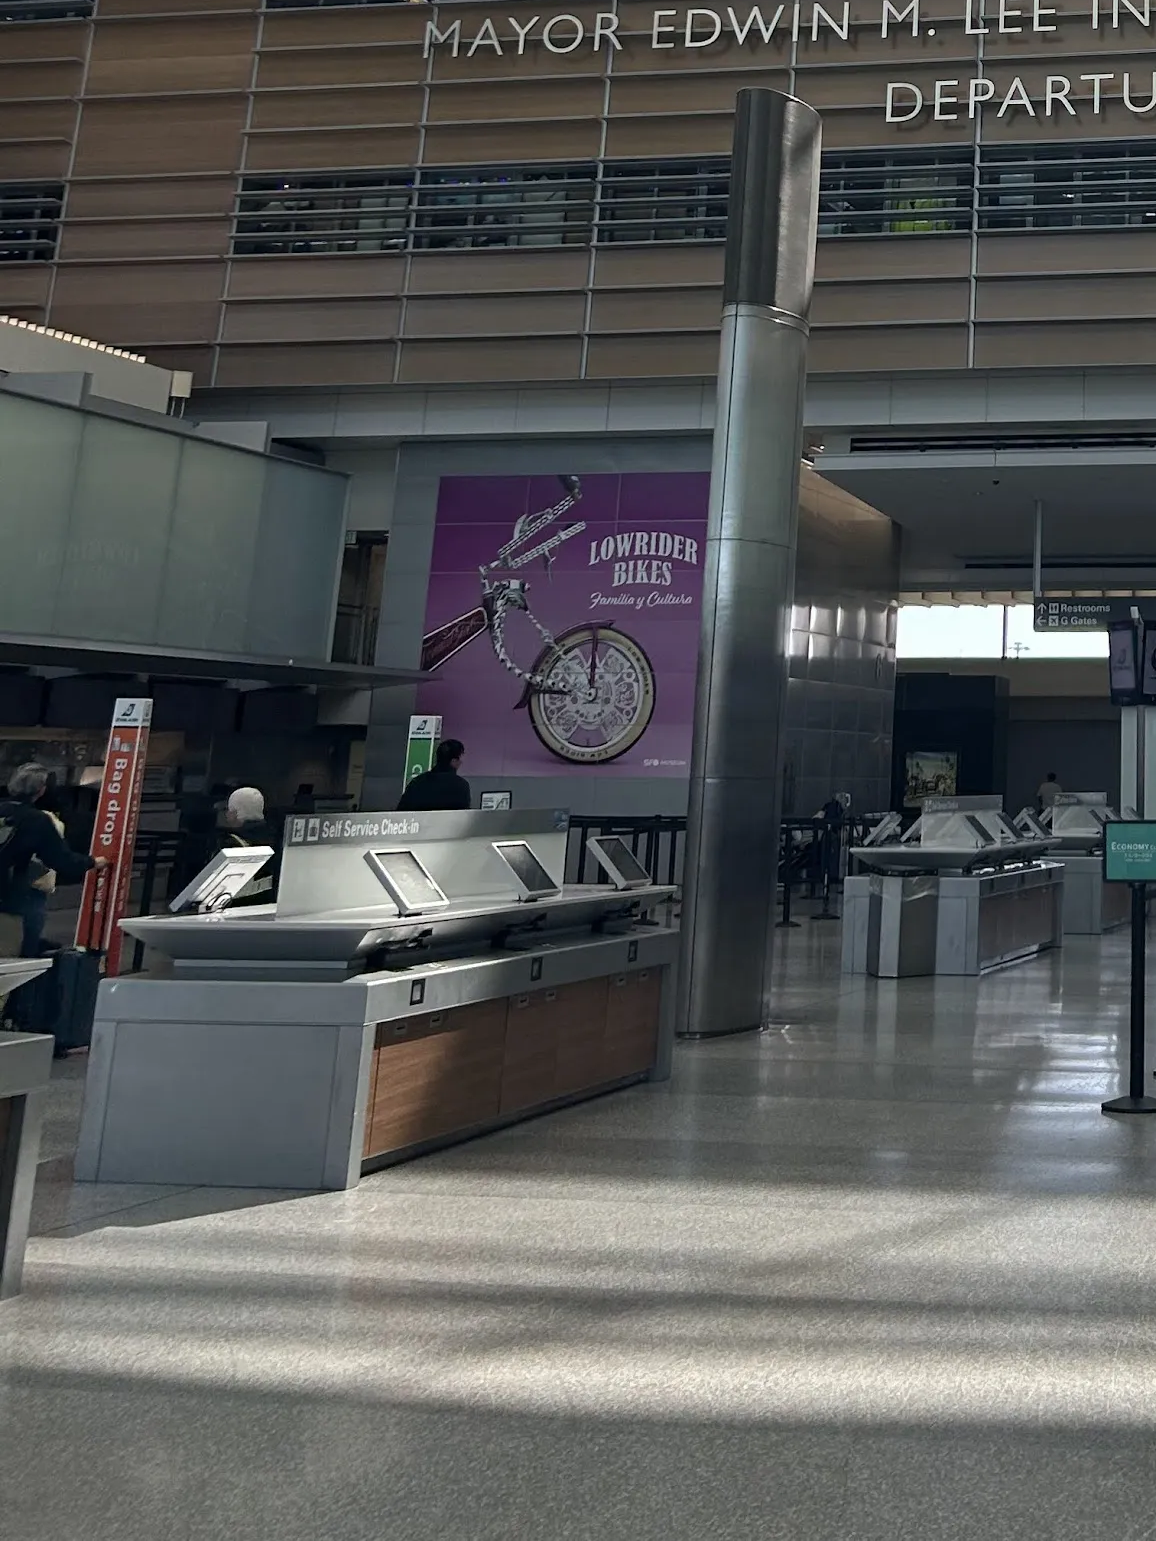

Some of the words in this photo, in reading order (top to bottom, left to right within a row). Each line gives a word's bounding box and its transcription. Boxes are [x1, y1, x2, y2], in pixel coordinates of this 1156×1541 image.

[422, 12, 622, 58] MAYOR
[651, 1, 853, 51] EDWIN
[588, 531, 698, 565] LOWRIDER
[612, 559, 672, 587] BIKES
[588, 592, 634, 609] Familia
[635, 597, 645, 609] y
[647, 591, 693, 607] Cultura
[1060, 603, 1111, 613] Restrooms
[1060, 616, 1069, 625] G
[1070, 616, 1098, 625] Gates
[643, 758, 660, 767] SFO
[107, 758, 128, 794] Bag
[100, 799, 121, 846] drop
[321, 820, 342, 838] Self
[343, 819, 379, 837] Service
[381, 818, 420, 836] Check-in
[1111, 841, 1150, 851] ECONOMY
